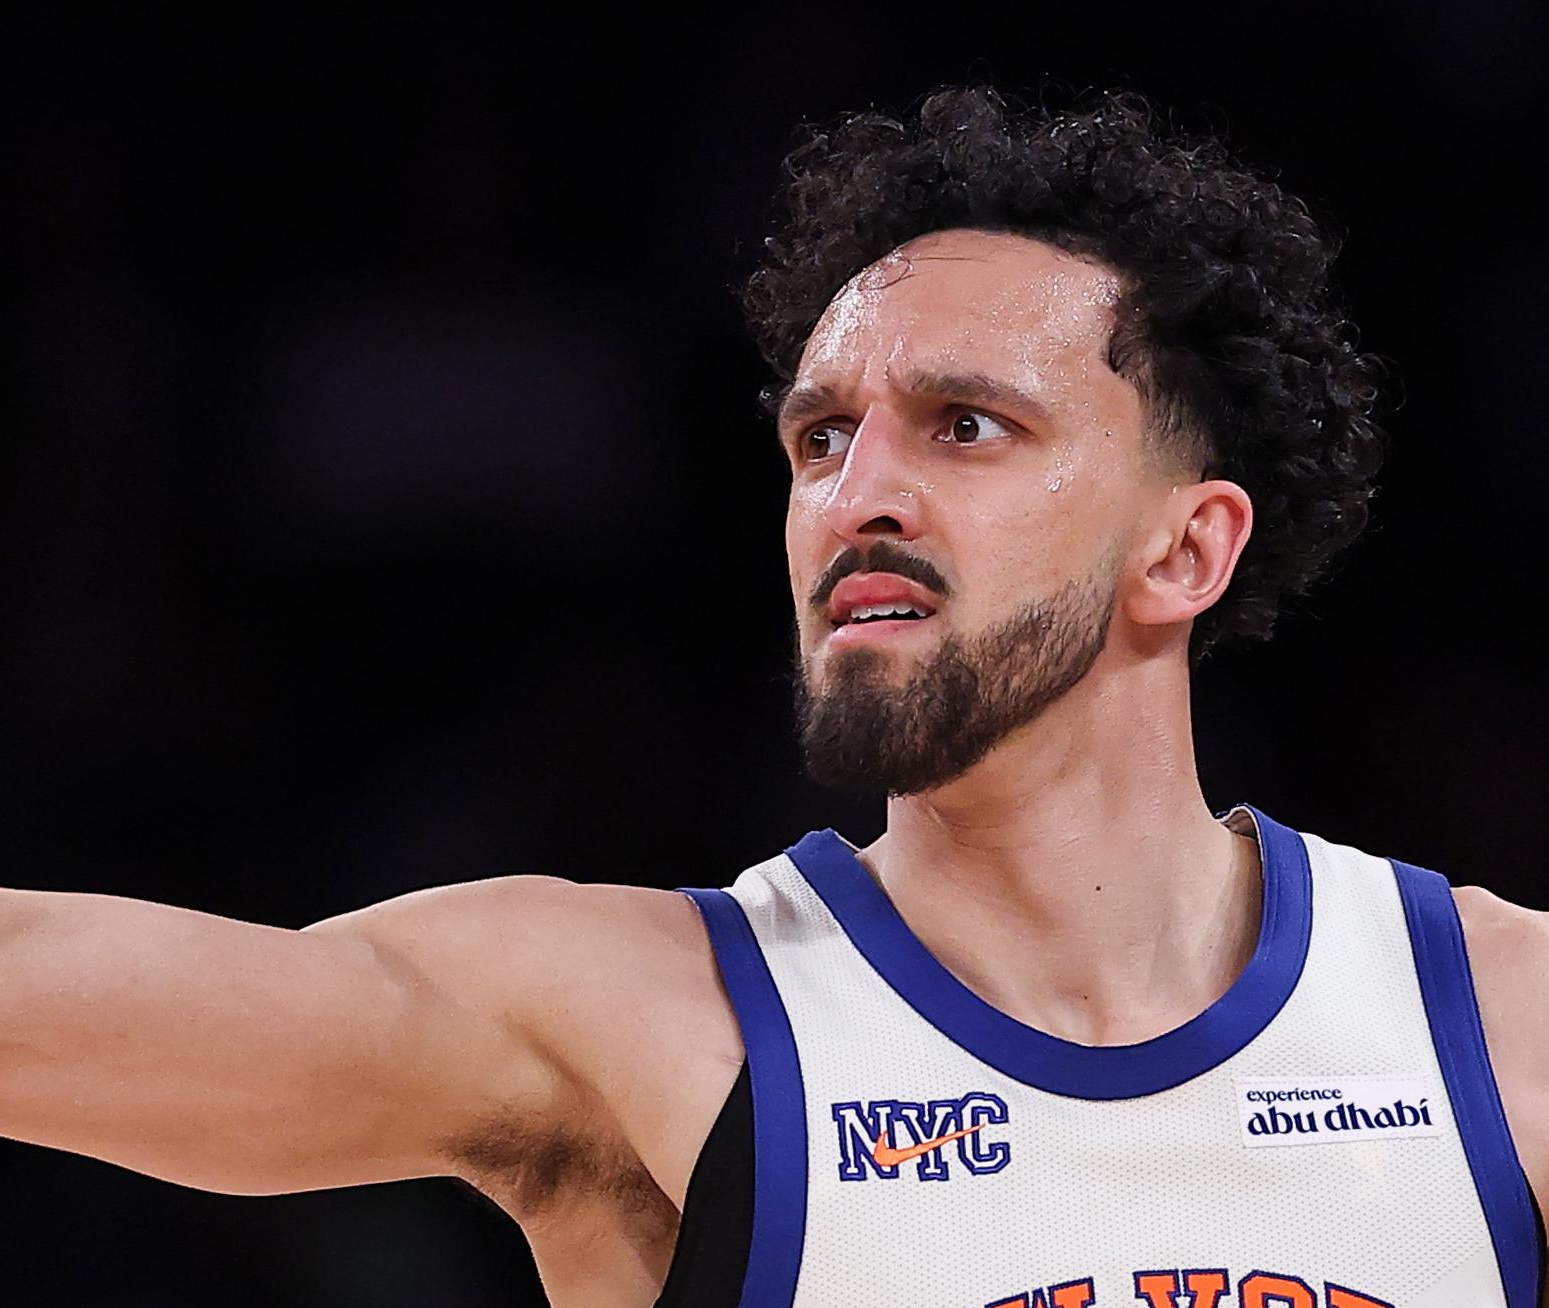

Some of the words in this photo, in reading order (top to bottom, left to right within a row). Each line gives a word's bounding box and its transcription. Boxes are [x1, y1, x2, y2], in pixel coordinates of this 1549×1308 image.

[1246, 1087, 1343, 1105] experience
[1247, 1105, 1320, 1136] abu
[1323, 1098, 1434, 1132] dhabi
[831, 1091, 1011, 1182] NYC
